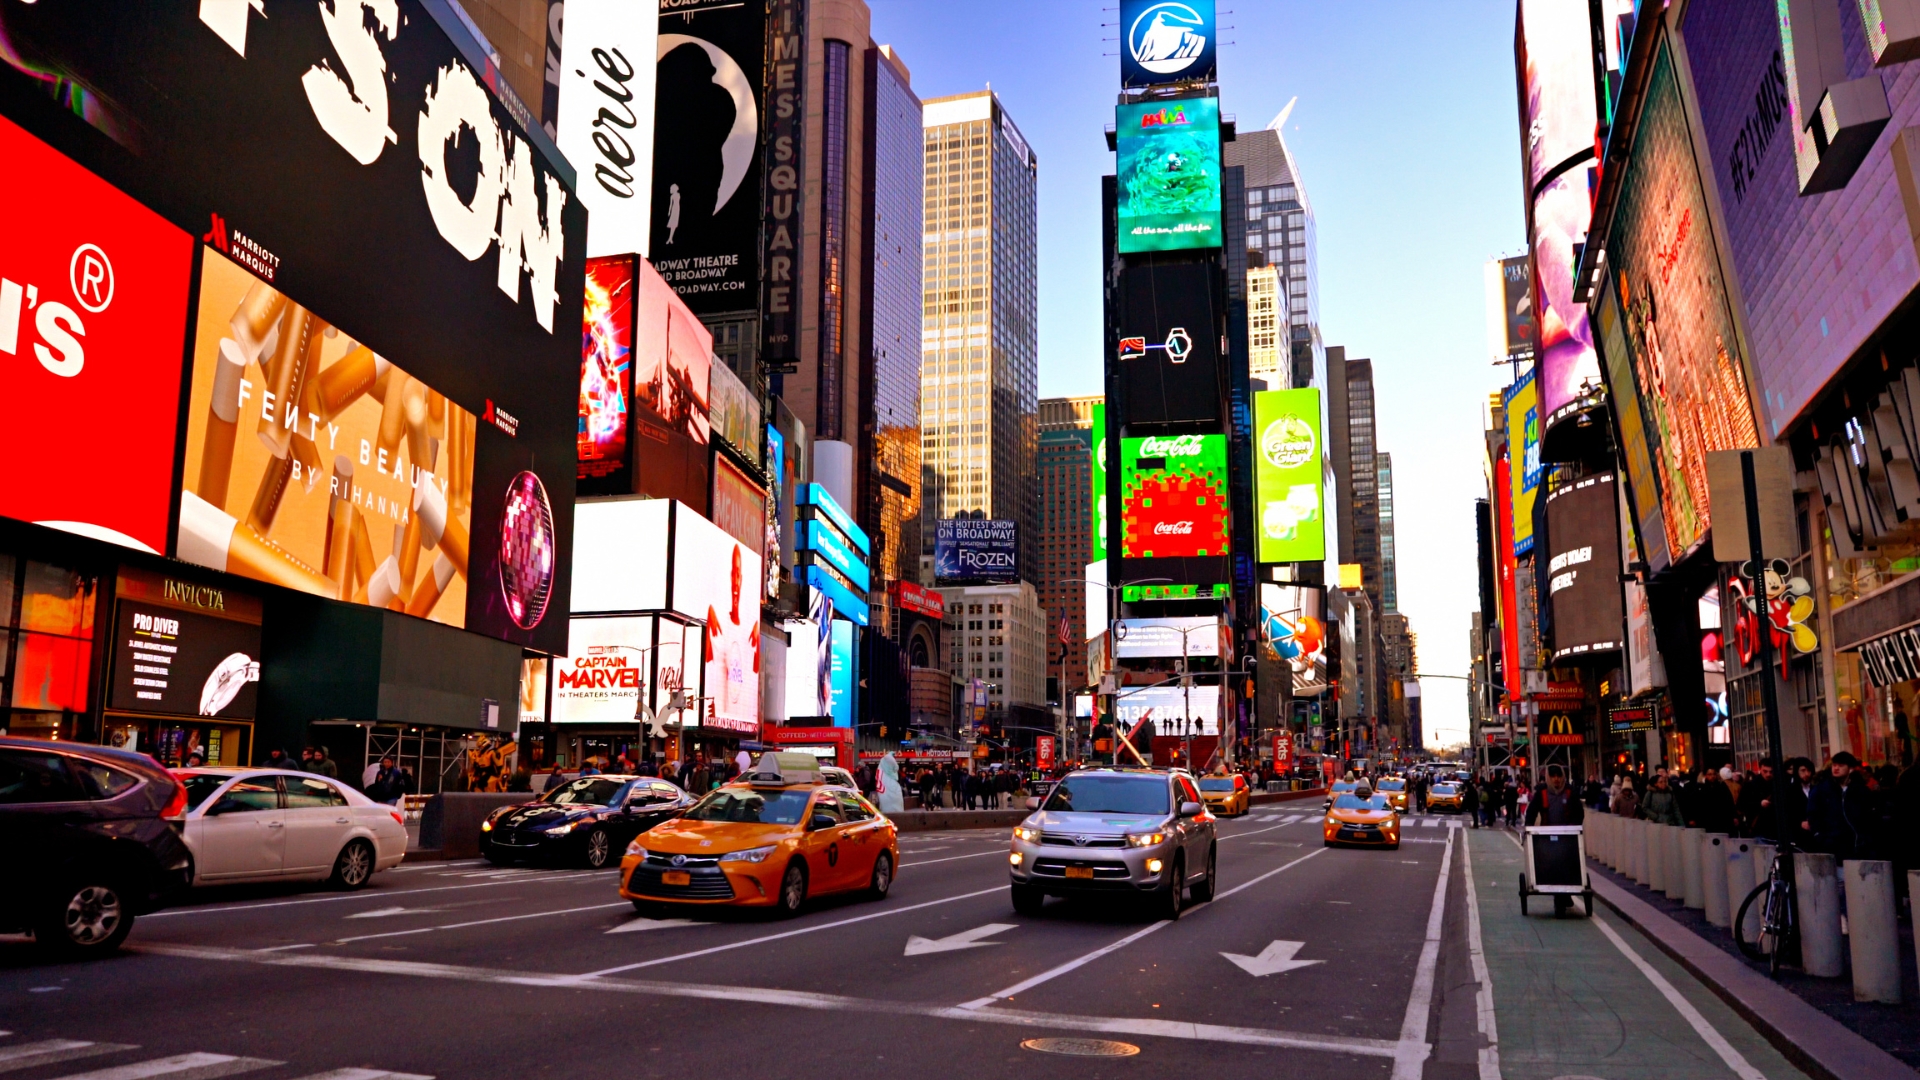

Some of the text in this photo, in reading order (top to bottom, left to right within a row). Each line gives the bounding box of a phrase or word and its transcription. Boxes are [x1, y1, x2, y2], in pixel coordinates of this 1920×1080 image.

[575, 46, 637, 199] aerie
[768, 0, 800, 314] IMES SQUARE
[233, 229, 280, 268] MARRIOTT
[232, 244, 274, 279] MARQUIS
[693, 254, 739, 268] THEATRE
[675, 267, 727, 281] BROADWAY
[769, 334, 788, 342] NYC
[237, 378, 340, 450] FENTY
[360, 438, 450, 502] BEAUTY
[1139, 434, 1206, 458] Coca-Cola
[1268, 440, 1311, 453] Green
[1273, 451, 1313, 465] Giant
[292, 459, 316, 486] BY
[330, 475, 410, 524] RIHANNA
[938, 520, 1015, 529] THE HOTTEST SNOW
[938, 528, 1015, 541] ON BROADWAY!
[1154, 521, 1194, 535] Coca-Cola
[959, 549, 1015, 569] FROZEN
[164, 578, 226, 611] INVICTA
[133, 613, 179, 635] PRO DIVER
[574, 656, 627, 669] CAPTAIN
[558, 668, 646, 689] MARVEL
[1040, 738, 1052, 760] tkts
[1277, 738, 1289, 760] tkts
